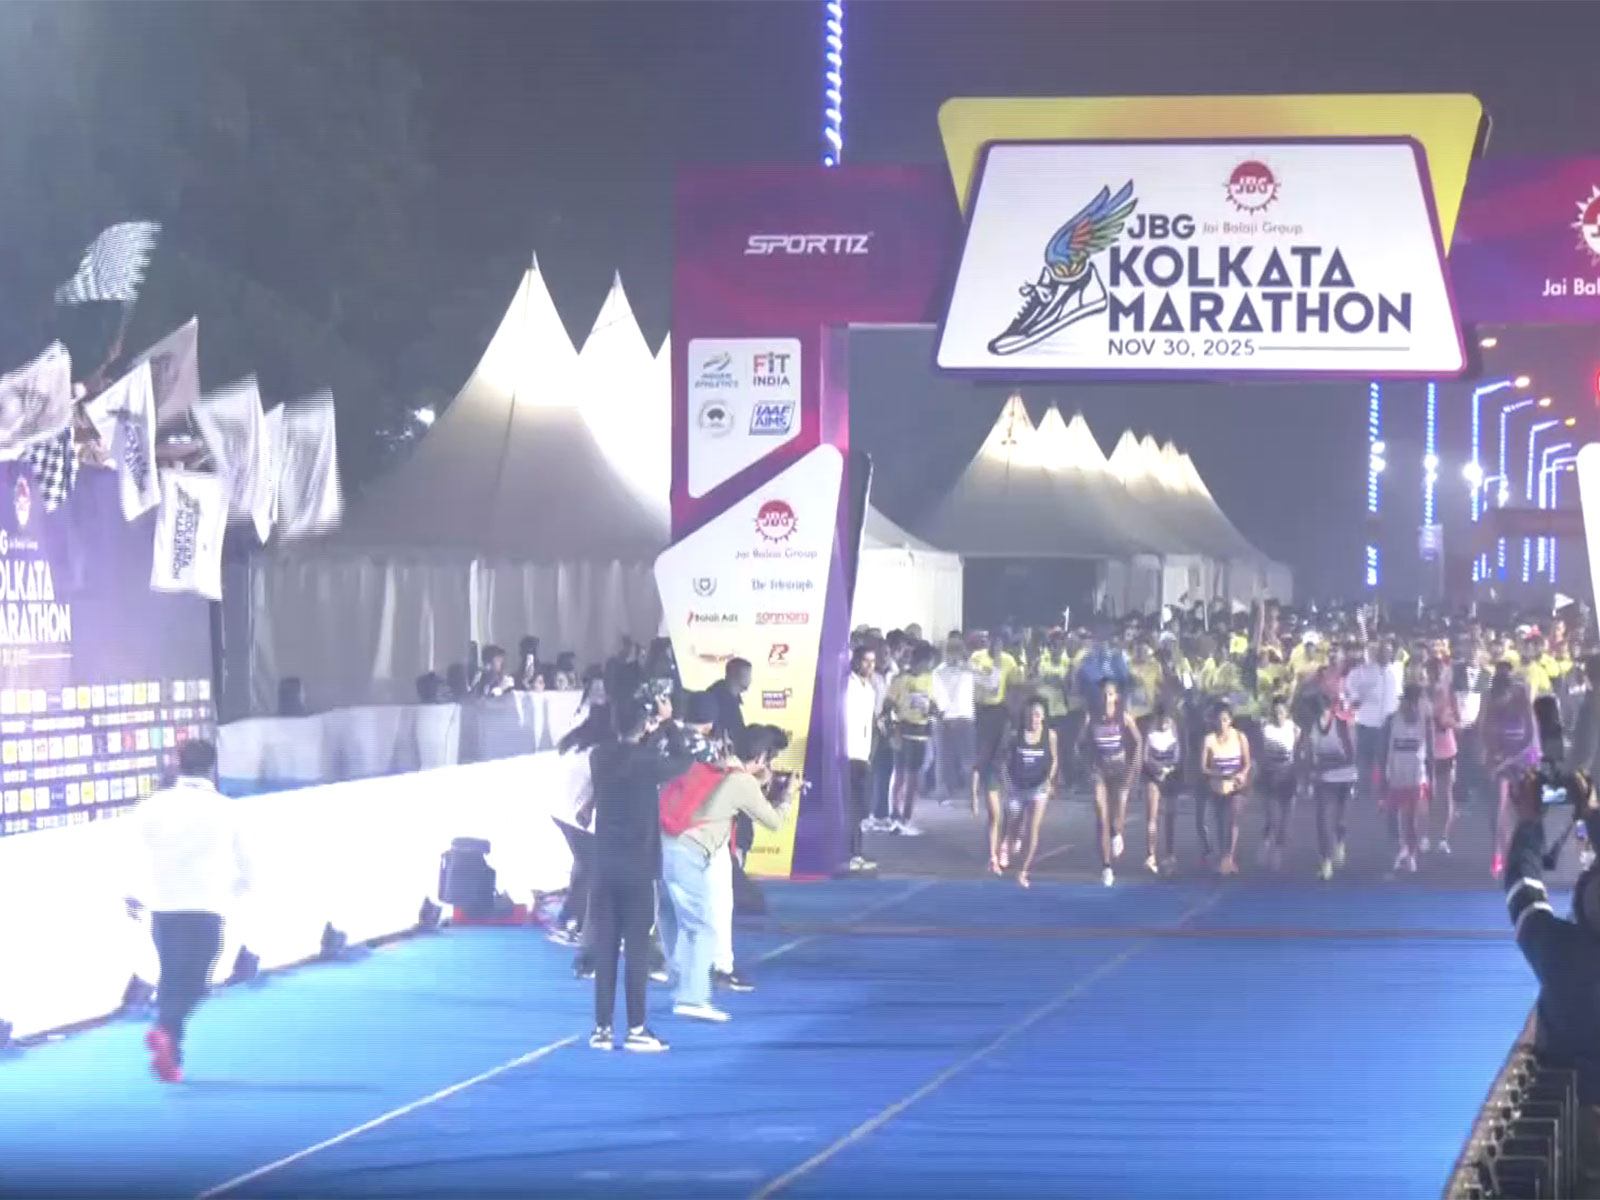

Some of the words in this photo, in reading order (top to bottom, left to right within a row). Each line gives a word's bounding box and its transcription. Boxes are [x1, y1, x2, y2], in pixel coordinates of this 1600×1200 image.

[1236, 177, 1268, 193] JBG
[1128, 213, 1195, 239] JBG
[1262, 222, 1303, 235] Group
[744, 234, 869, 254] SPORTIZ
[1109, 246, 1355, 287] KOLKATA
[1542, 278, 1567, 296] Jai
[1109, 291, 1411, 333] MARATHON
[1108, 339, 1155, 355] NOV
[1163, 339, 1195, 357] 30,
[1203, 339, 1254, 355] 2025
[753, 375, 790, 386] INDIA
[785, 548, 817, 559] Group
